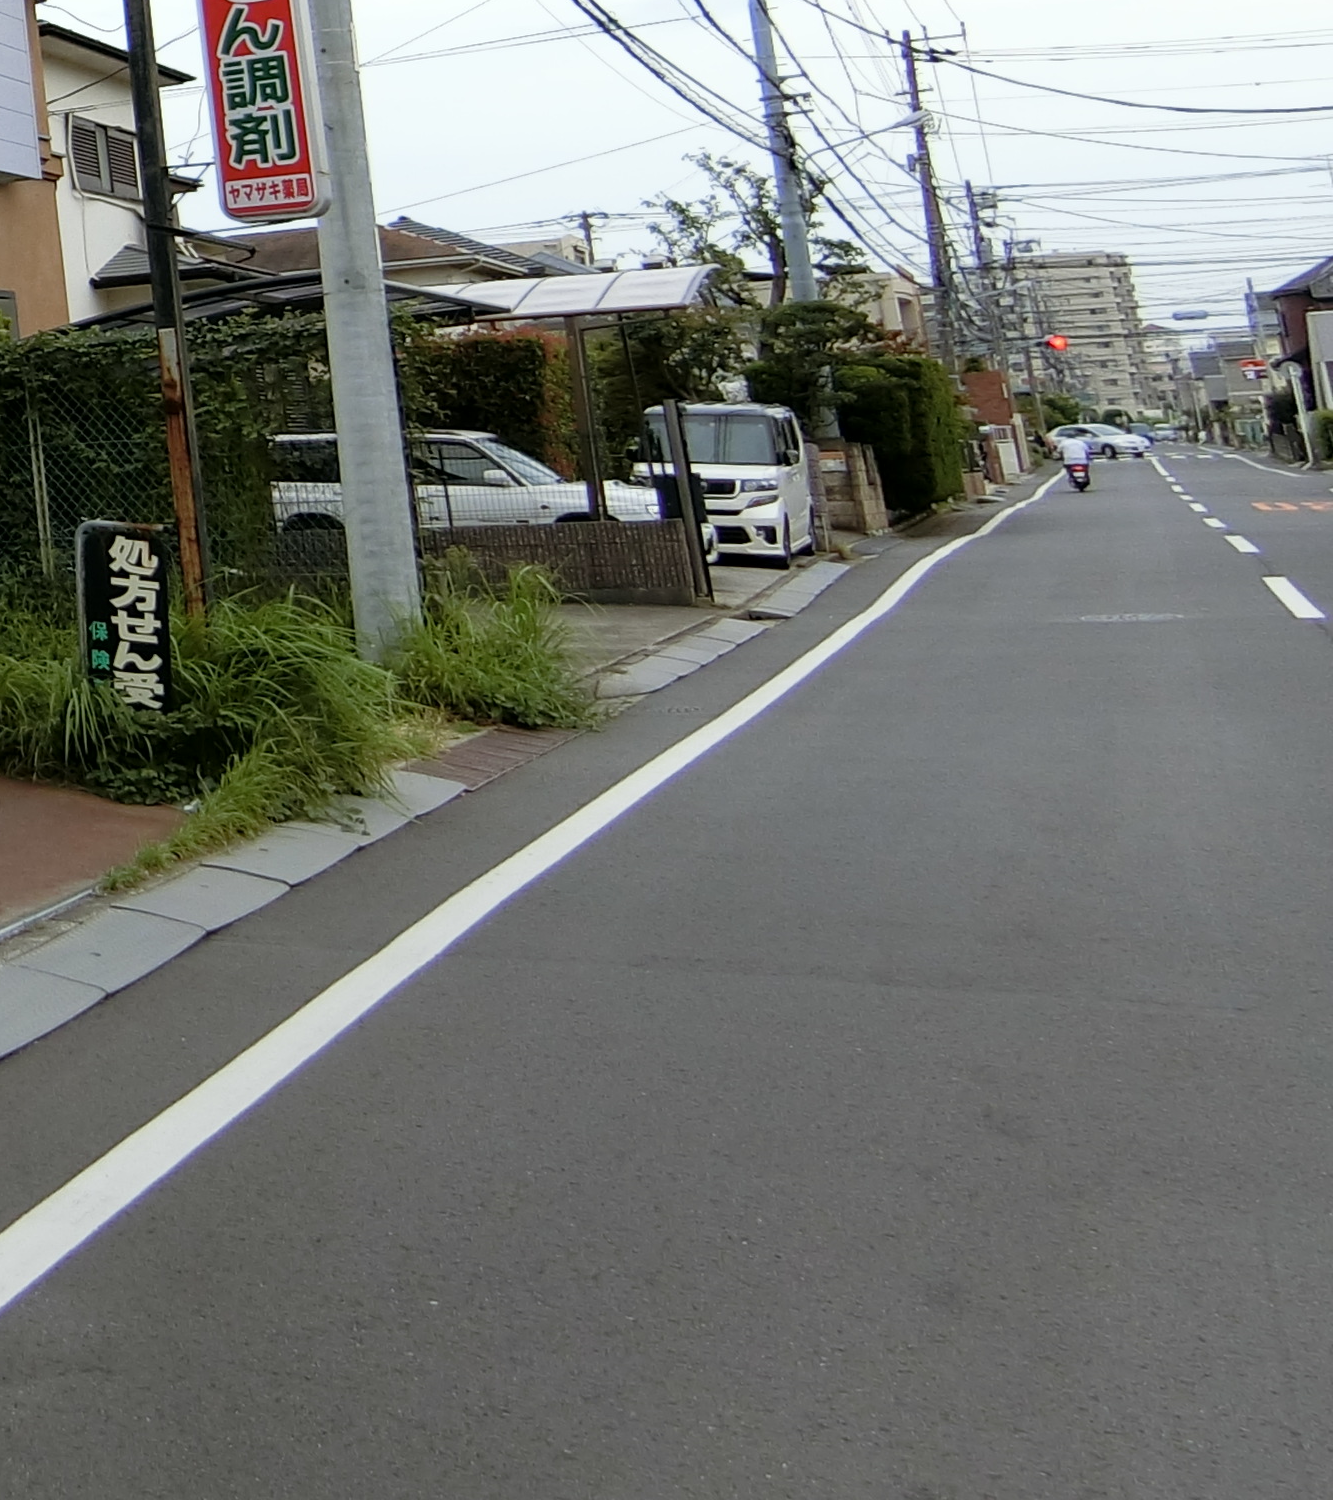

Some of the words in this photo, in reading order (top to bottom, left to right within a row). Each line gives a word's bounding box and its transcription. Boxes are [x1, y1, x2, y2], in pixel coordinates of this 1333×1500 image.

[228, 177, 309, 205] ヤマザキ薬局
[88, 620, 111, 686] 保険
